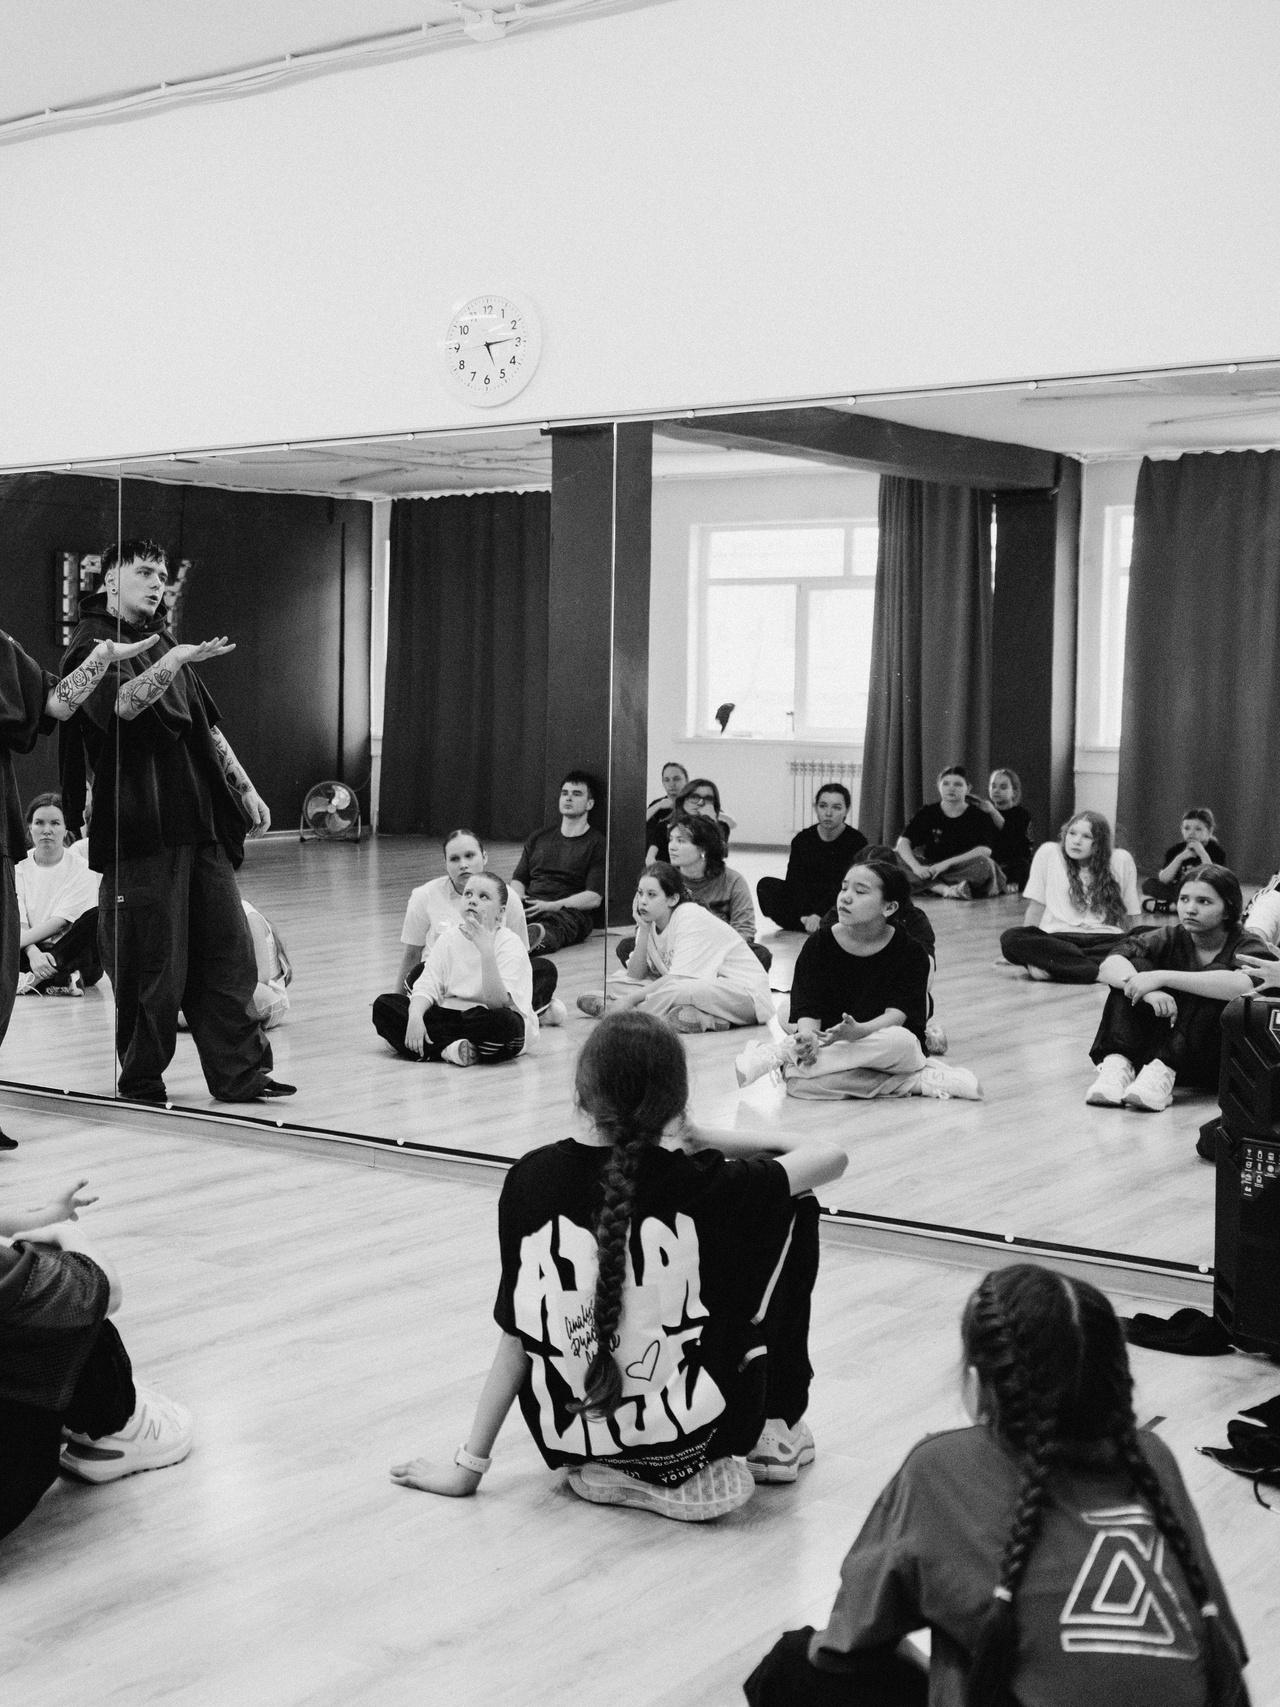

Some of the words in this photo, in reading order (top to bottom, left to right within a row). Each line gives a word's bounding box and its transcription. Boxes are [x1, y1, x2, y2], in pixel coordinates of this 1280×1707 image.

[483, 305, 493, 315] 12
[501, 308, 505, 319] 1
[459, 325, 469, 335] 10
[510, 320, 517, 330] 2
[515, 336, 521, 347] 3
[454, 343, 461, 353] 9
[458, 360, 465, 370] 8
[509, 355, 516, 365] 4
[470, 371, 477, 381] 7
[500, 368, 506, 379] 5
[484, 375, 491, 385] 6
[144, 1419, 162, 1441] N
[676, 1447, 696, 1458] WITH
[661, 1467, 694, 1484] YOUR
